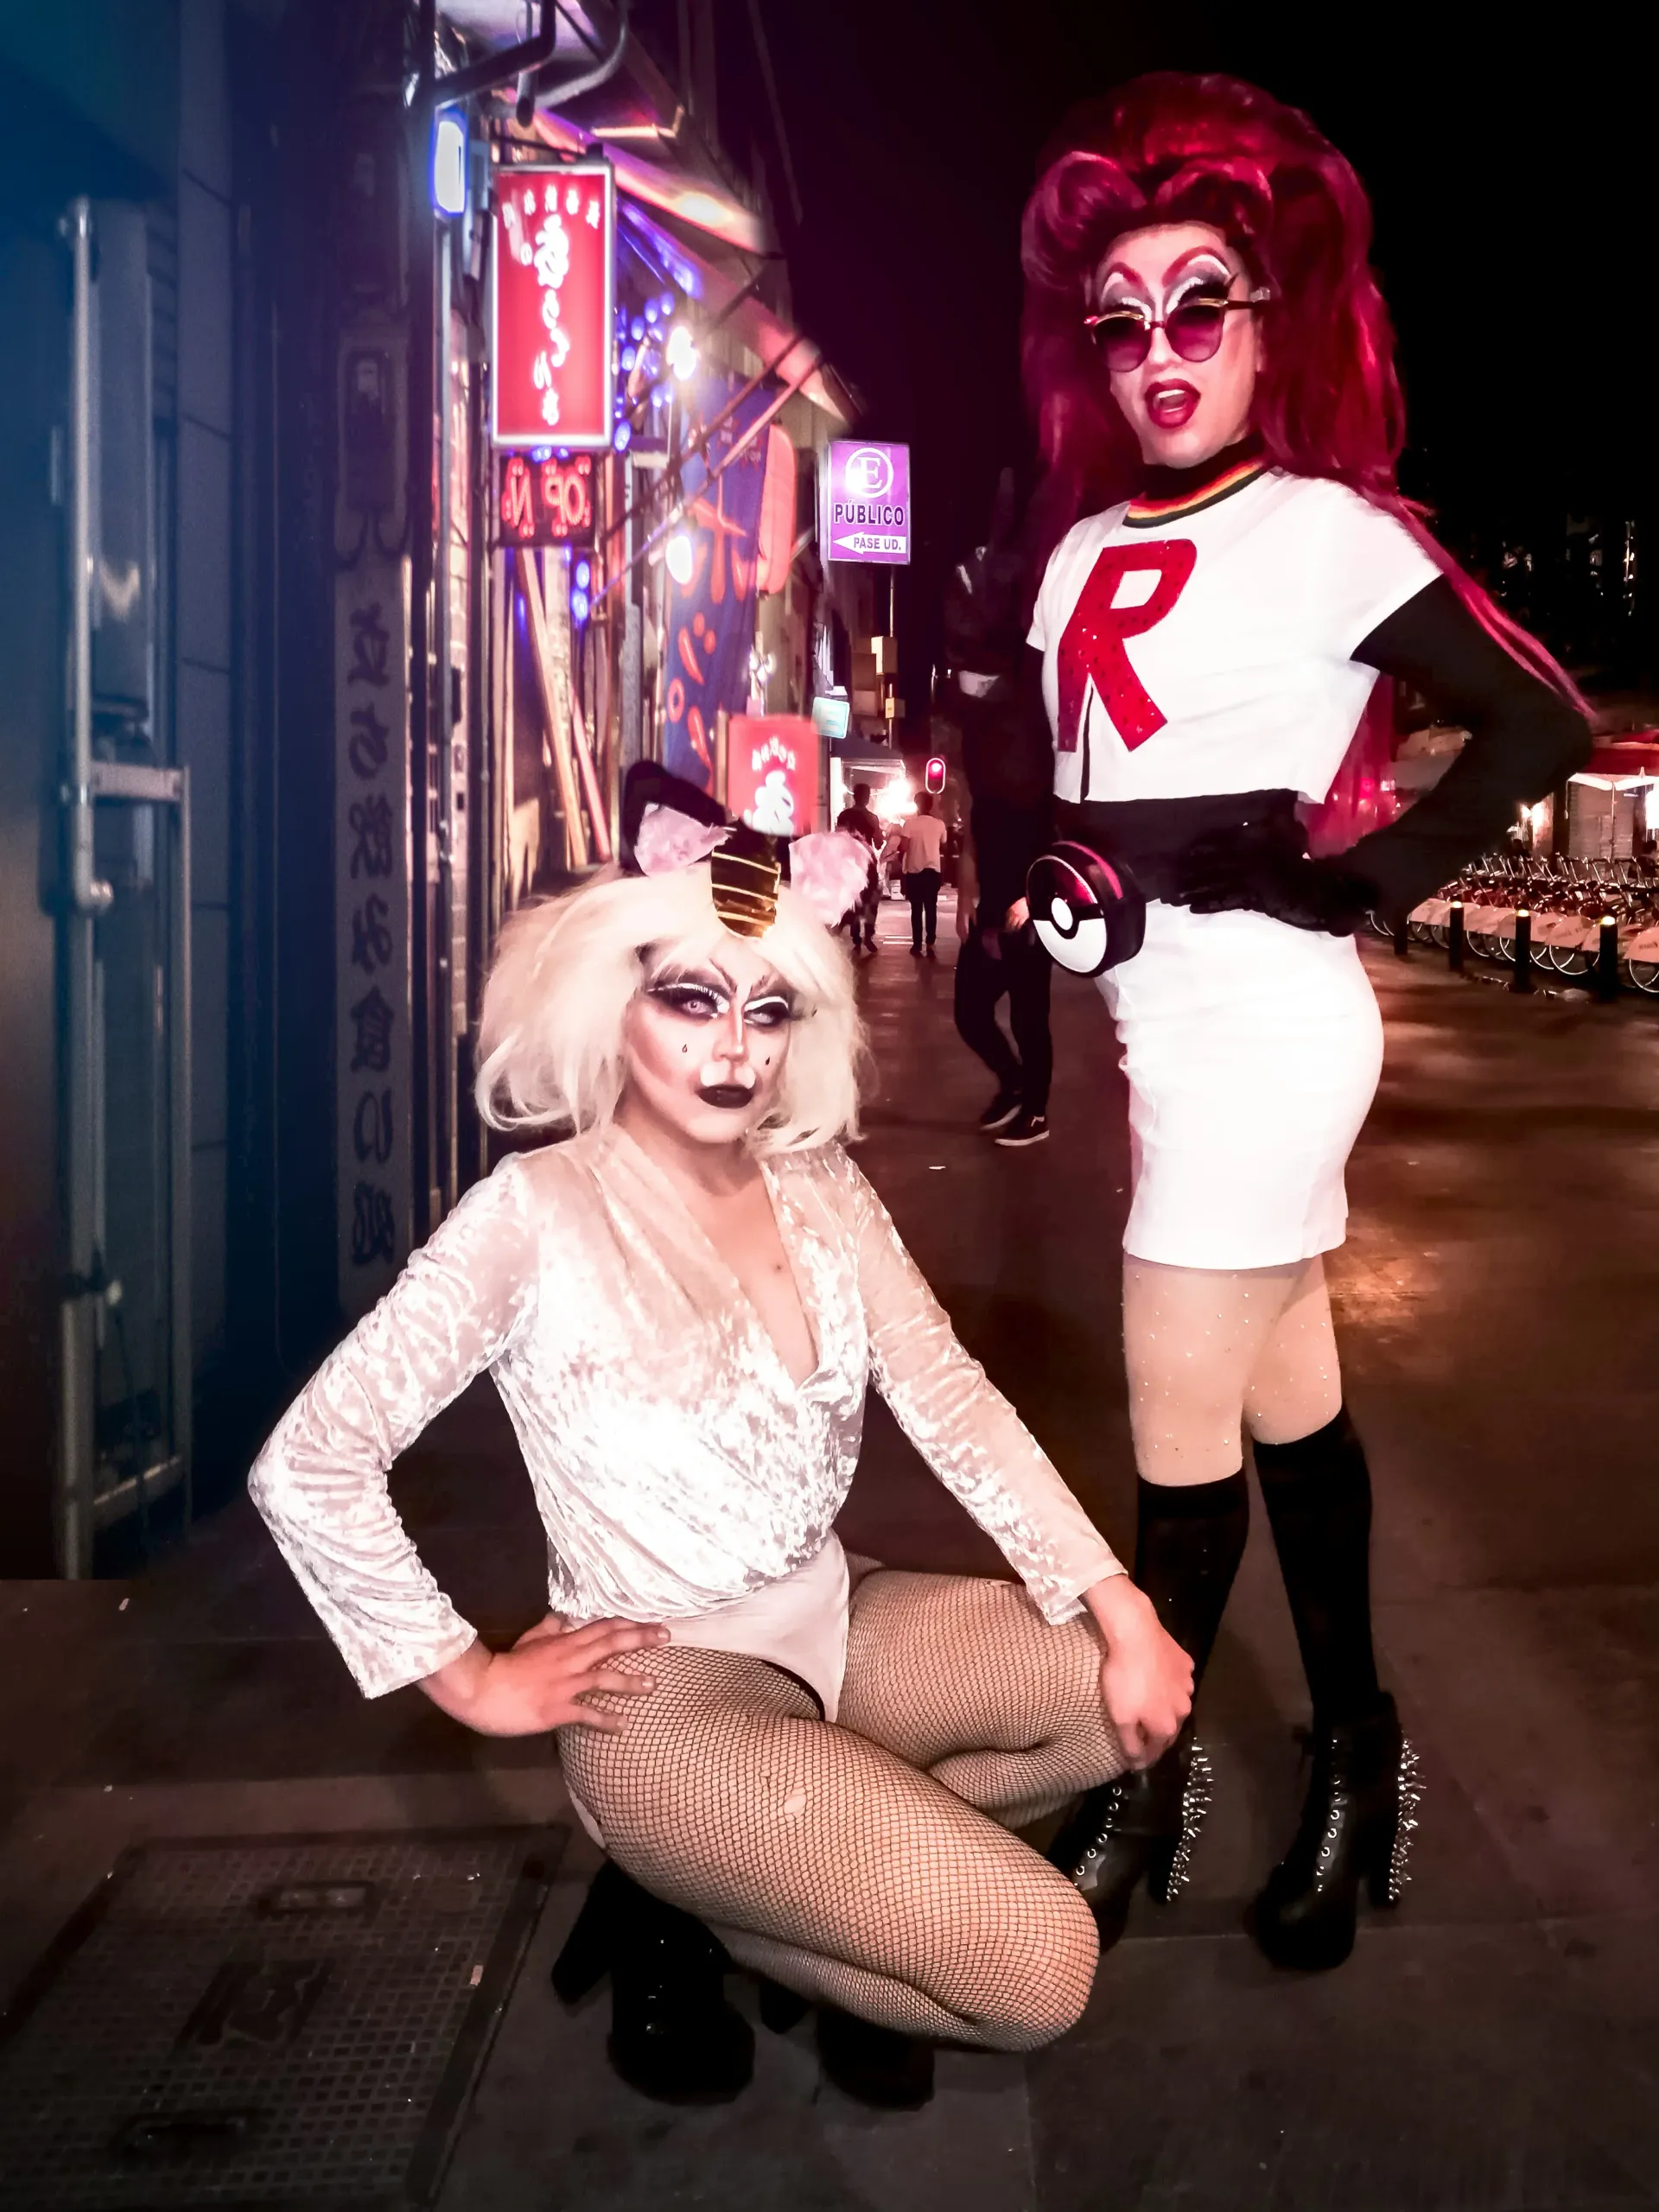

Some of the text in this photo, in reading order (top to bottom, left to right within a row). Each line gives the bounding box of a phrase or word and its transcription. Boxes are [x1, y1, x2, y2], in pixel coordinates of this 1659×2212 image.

[856, 457, 882, 489] E
[834, 499, 905, 525] PÚBLICO
[853, 537, 902, 550] PASE UD.
[1057, 538, 1198, 753] R
